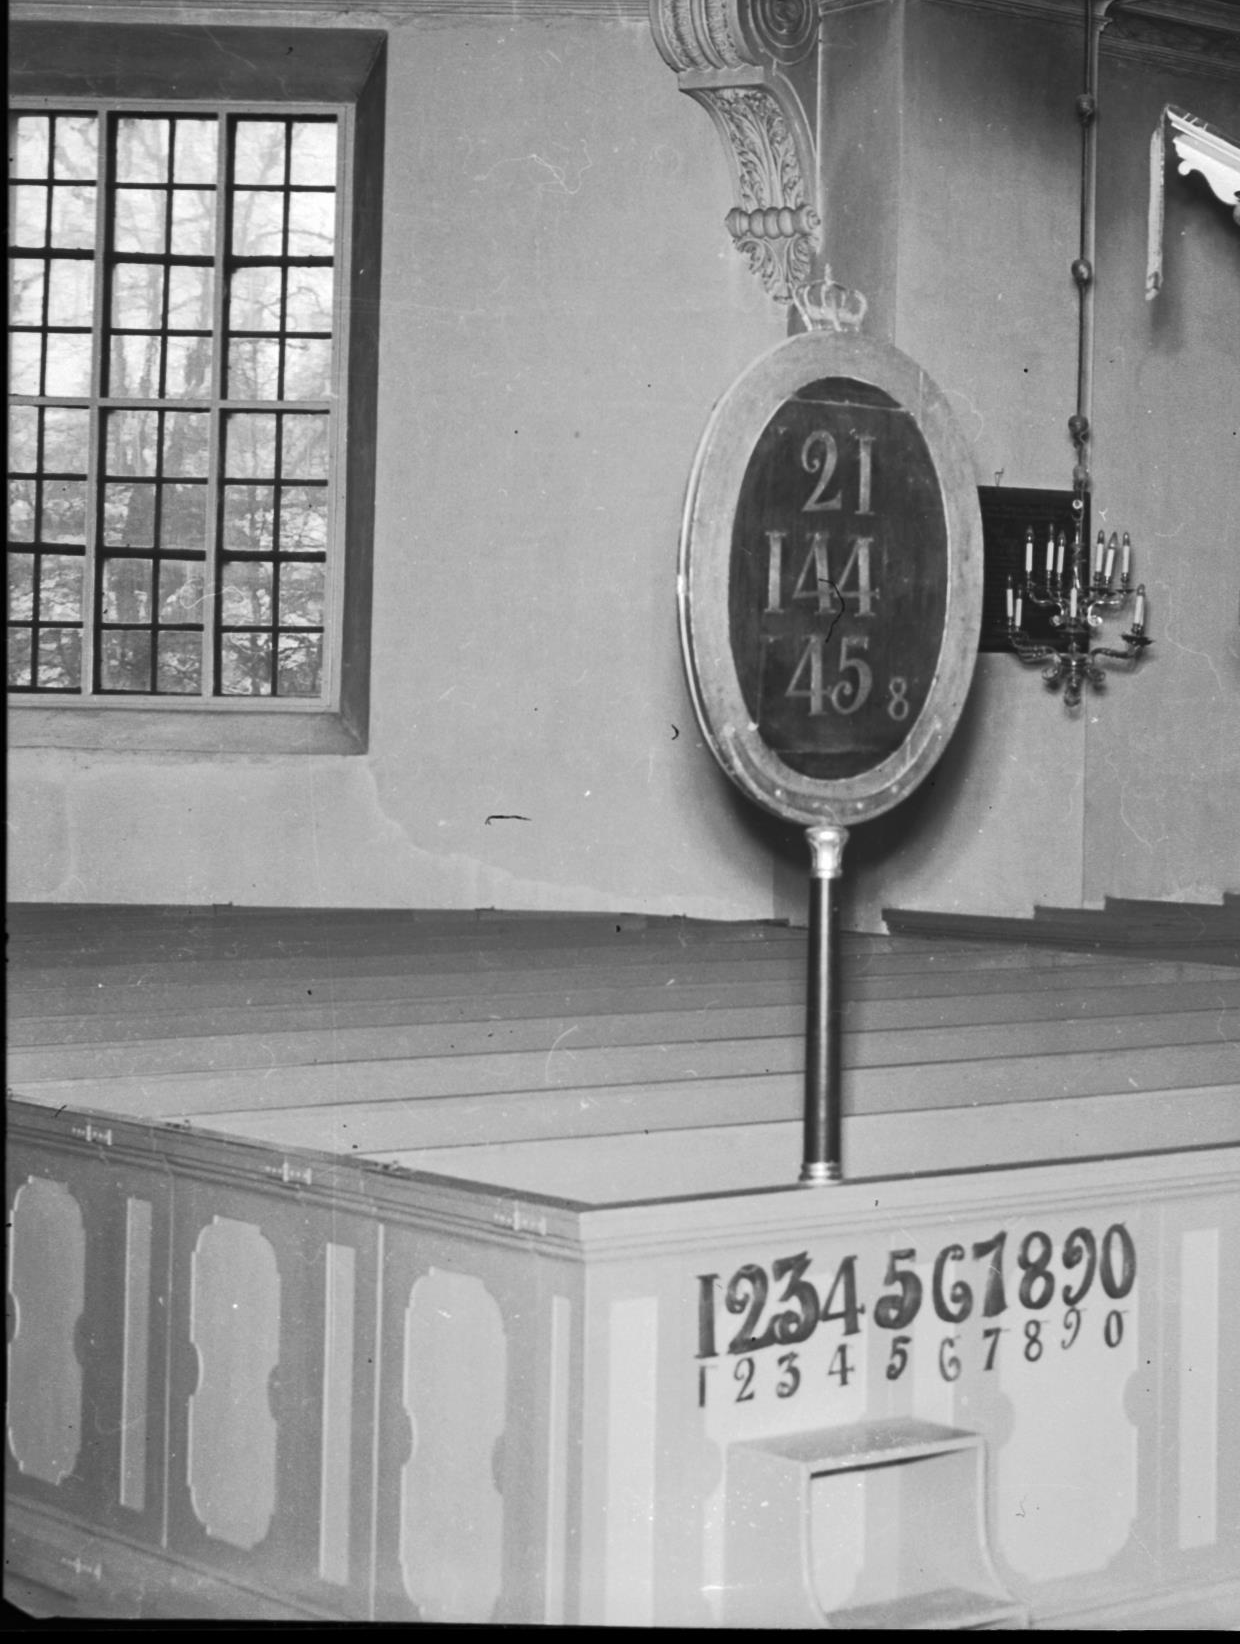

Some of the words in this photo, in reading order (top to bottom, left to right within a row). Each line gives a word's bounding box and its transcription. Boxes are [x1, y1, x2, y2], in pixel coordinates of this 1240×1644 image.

[802, 430, 875, 514] 21
[764, 530, 879, 617] 144
[785, 635, 872, 716] 45
[888, 676, 909, 720] 8
